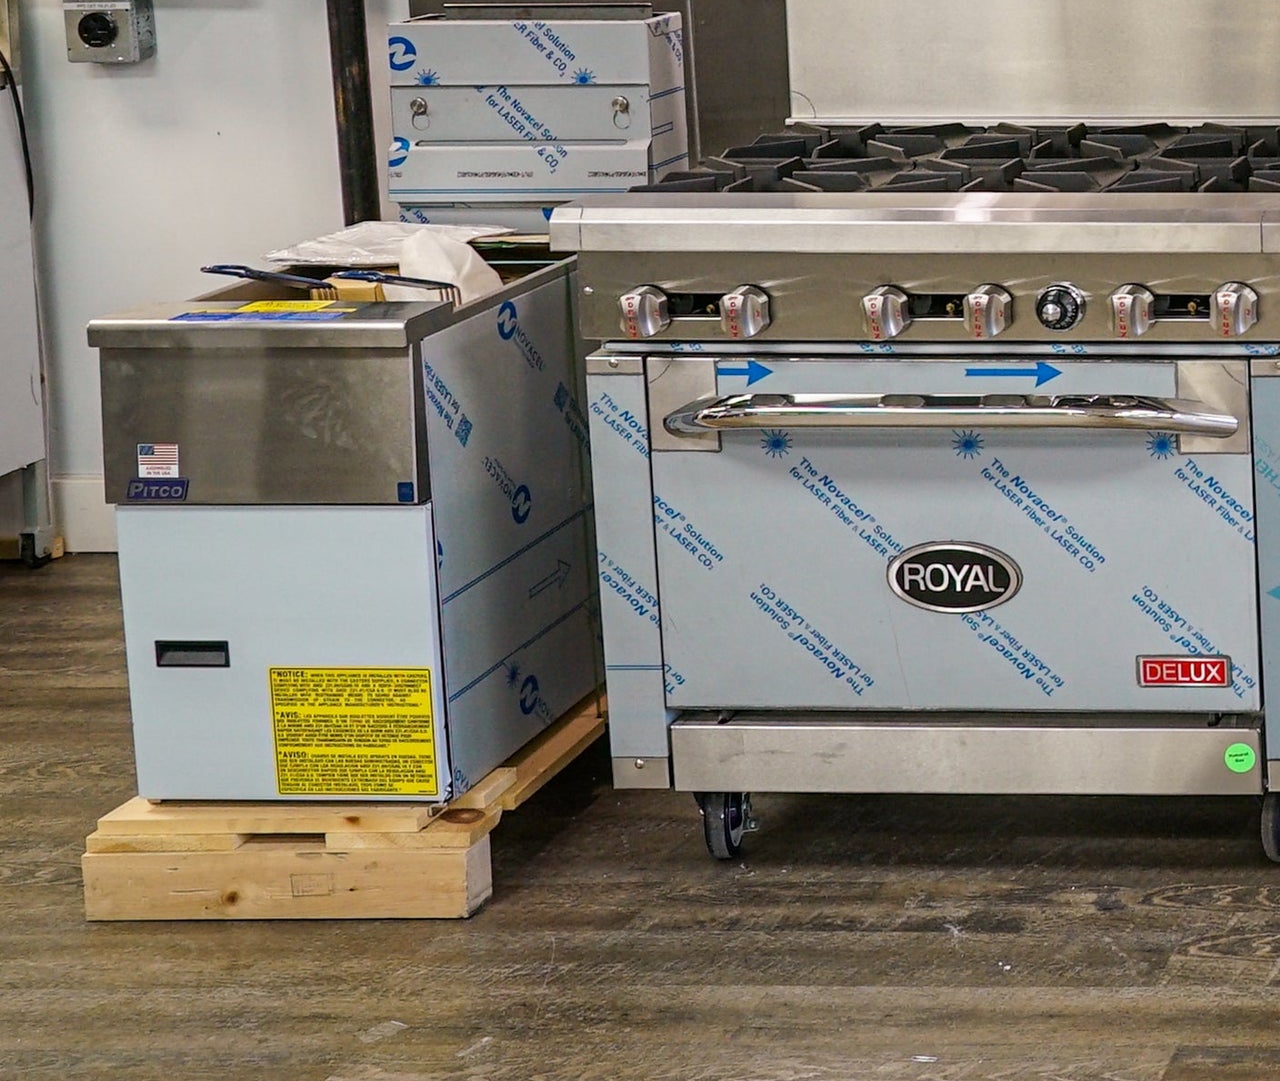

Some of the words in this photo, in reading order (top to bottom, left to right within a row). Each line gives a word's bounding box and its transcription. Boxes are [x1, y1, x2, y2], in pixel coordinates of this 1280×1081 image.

[524, 30, 546, 51] Fiber
[540, 26, 576, 62] Solution
[484, 95, 498, 110] for
[497, 107, 526, 137] LASER
[496, 85, 511, 101] The
[510, 99, 545, 133] Novacel
[599, 392, 619, 413] The
[590, 401, 605, 418] for
[604, 414, 633, 443] LASER
[1183, 458, 1204, 479] The
[129, 482, 183, 497] PITCO
[1174, 469, 1188, 484] for
[1187, 480, 1217, 508] LASER
[1216, 505, 1240, 528] Fiber
[789, 466, 802, 482] for
[802, 478, 830, 507] LASER
[831, 504, 854, 526] Fiber
[858, 529, 888, 557] LASER
[798, 456, 818, 478] The
[873, 524, 905, 554] Soluti
[981, 467, 994, 483] for
[994, 479, 1023, 507] LASER
[1022, 505, 1046, 527] Fiber
[1050, 529, 1079, 558] LASER
[991, 457, 1010, 478] The
[1065, 525, 1106, 564] Solution
[669, 527, 698, 556] LASER
[683, 523, 724, 562] Solution
[612, 565, 636, 588] Fiber
[903, 564, 1005, 593] ROYAL
[750, 592, 790, 631] Solution
[775, 598, 805, 626] LASER
[1132, 594, 1172, 632] Solution
[1157, 600, 1187, 628] LASER
[810, 629, 833, 651] Fiber
[1000, 629, 1023, 651] Fiber
[1191, 630, 1215, 653] Fiber
[832, 648, 862, 677] LASER
[1022, 648, 1053, 678] LASER
[1146, 663, 1222, 682] DELUX
[846, 676, 864, 696] The
[861, 672, 875, 688] for
[1035, 677, 1055, 697] The
[1052, 673, 1065, 688] for
[1242, 675, 1256, 689] for
